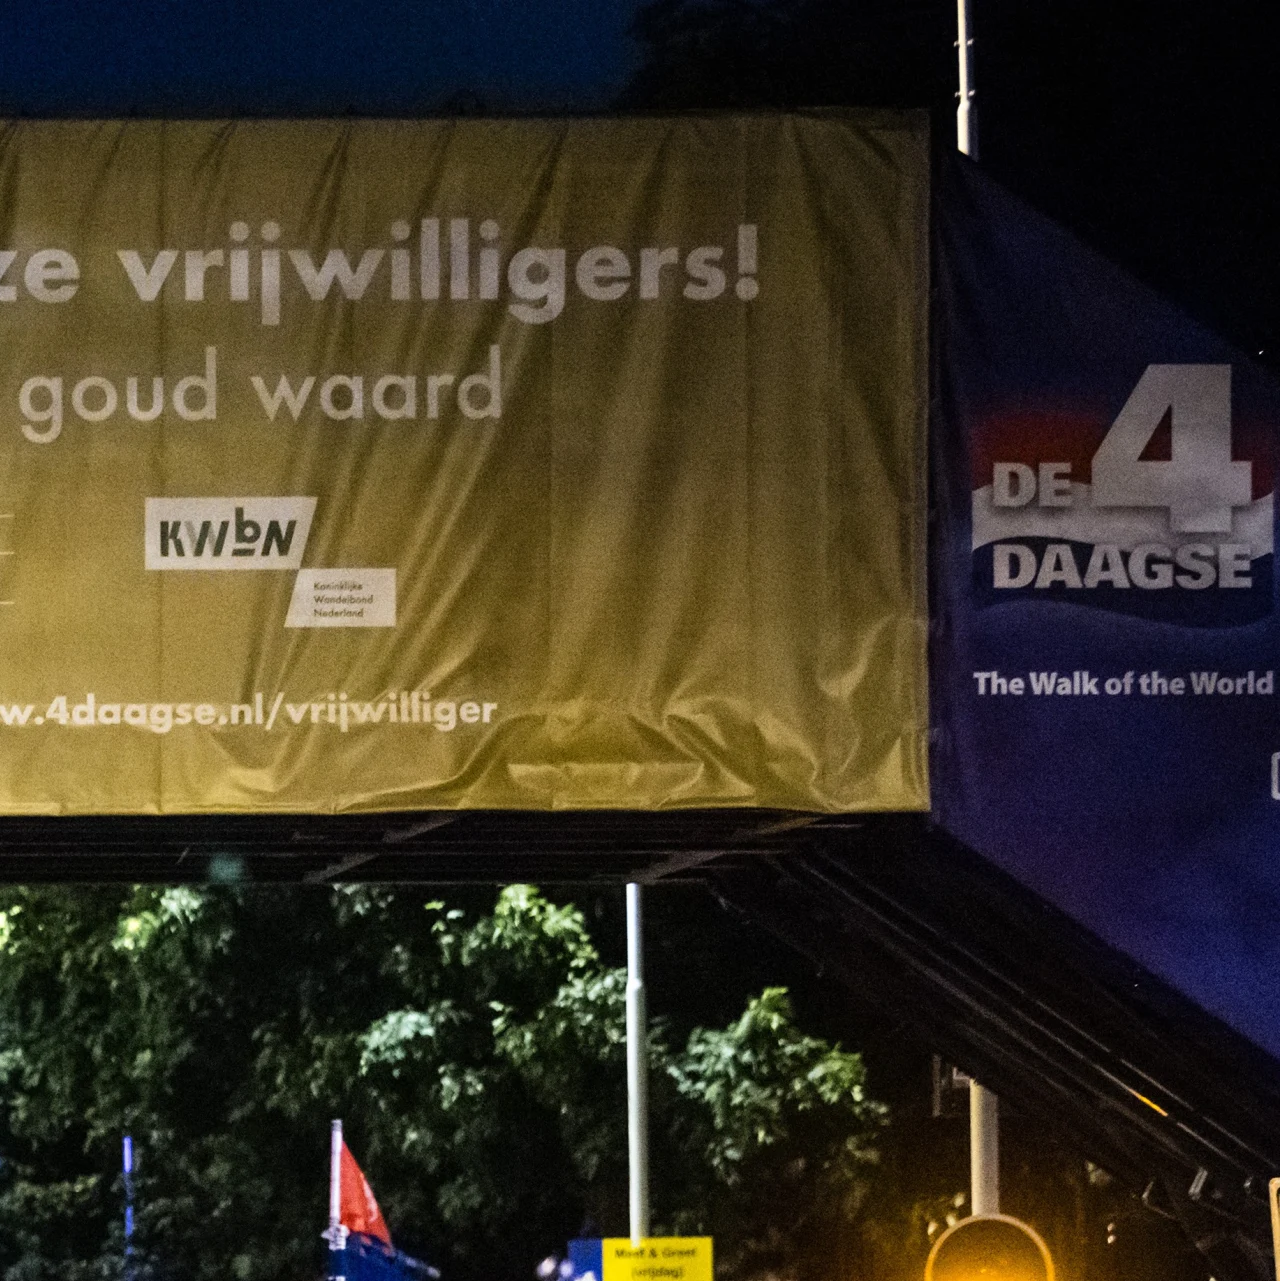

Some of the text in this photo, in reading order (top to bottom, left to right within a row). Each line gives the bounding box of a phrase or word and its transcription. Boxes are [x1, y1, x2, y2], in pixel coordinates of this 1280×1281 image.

[118, 219, 760, 326] vrijwilligers!
[19, 347, 218, 445] goud
[251, 345, 504, 421] waard
[993, 364, 1252, 533] DE 4
[993, 544, 1252, 589] DAAGSE
[973, 671, 1274, 695] The Walk of the World
